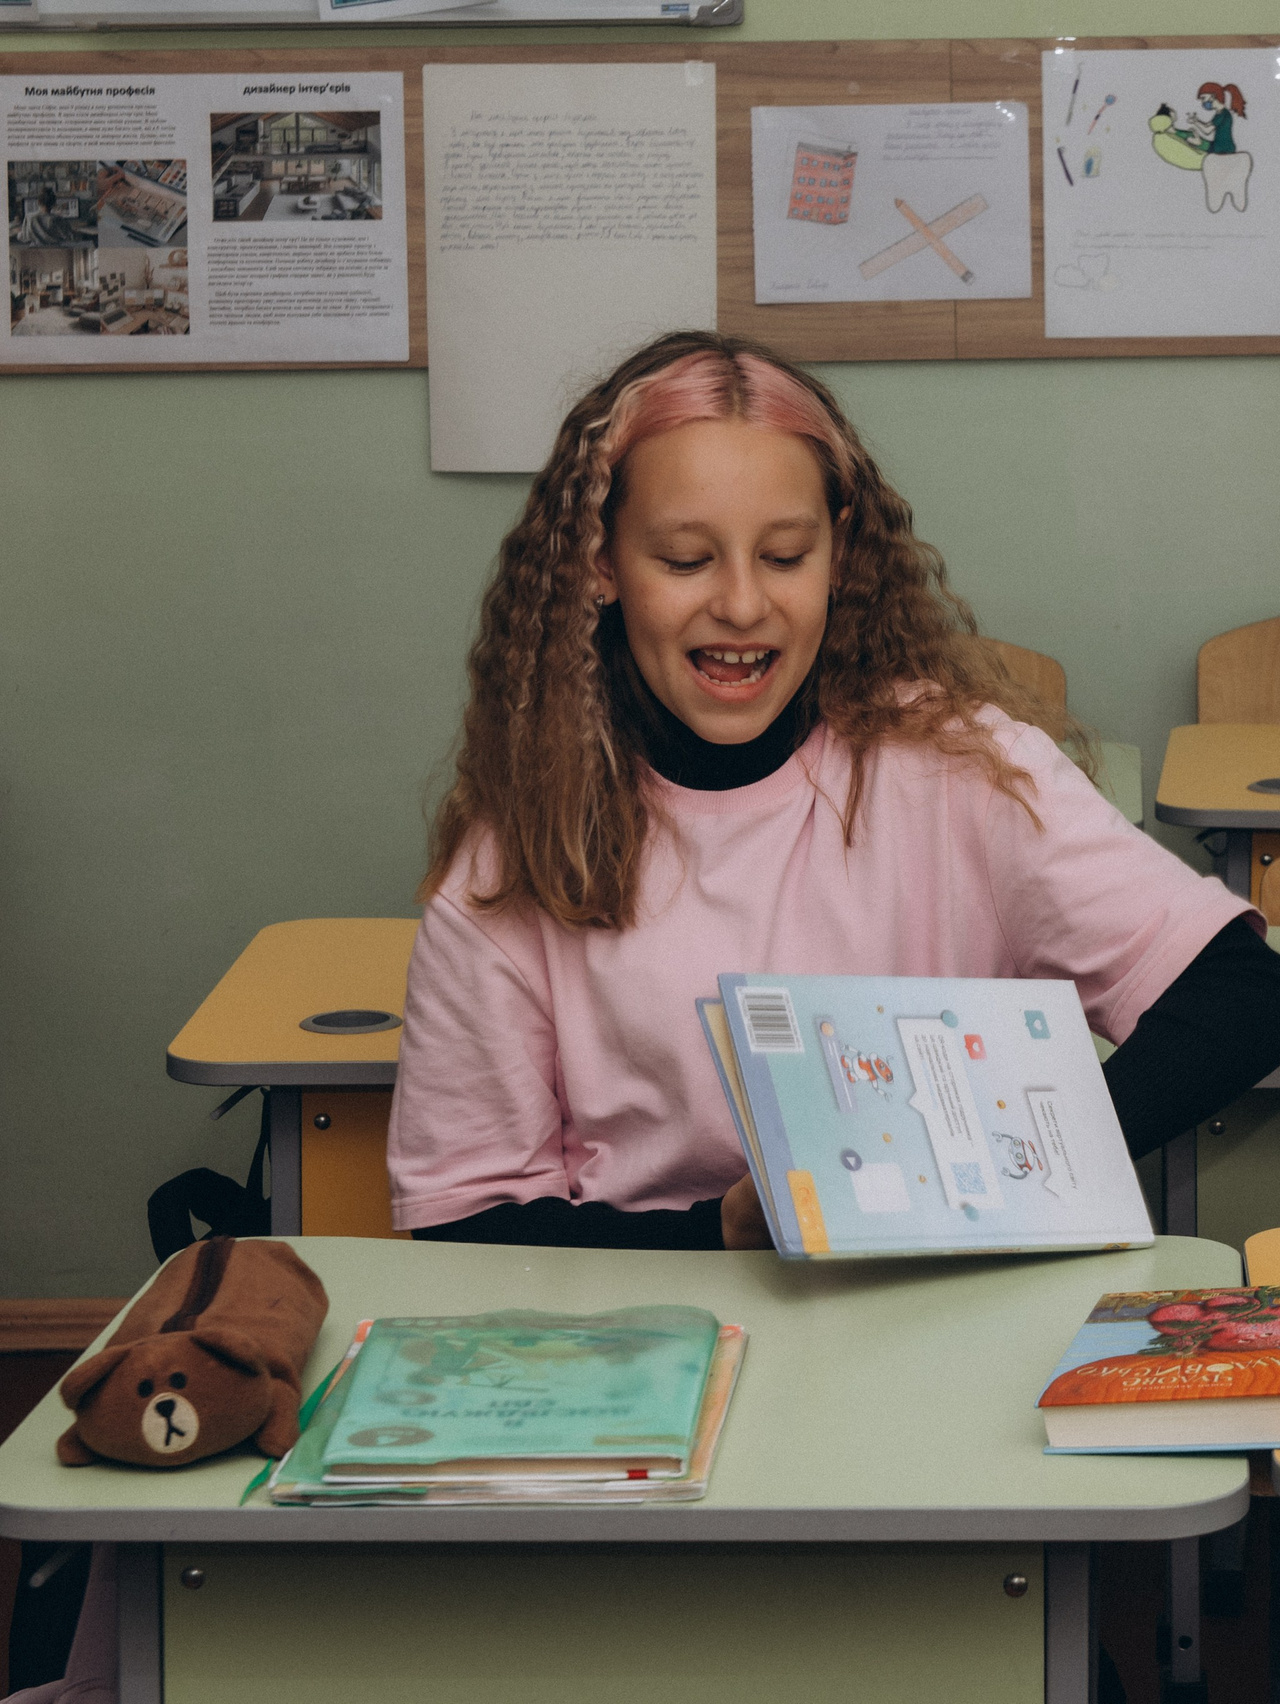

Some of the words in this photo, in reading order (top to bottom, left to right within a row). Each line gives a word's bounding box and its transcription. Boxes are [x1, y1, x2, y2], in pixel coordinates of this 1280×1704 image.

[25, 87, 48, 97] Моя
[51, 86, 103, 98] майбутня
[105, 85, 155, 98] професія
[243, 83, 296, 95] дизайнер
